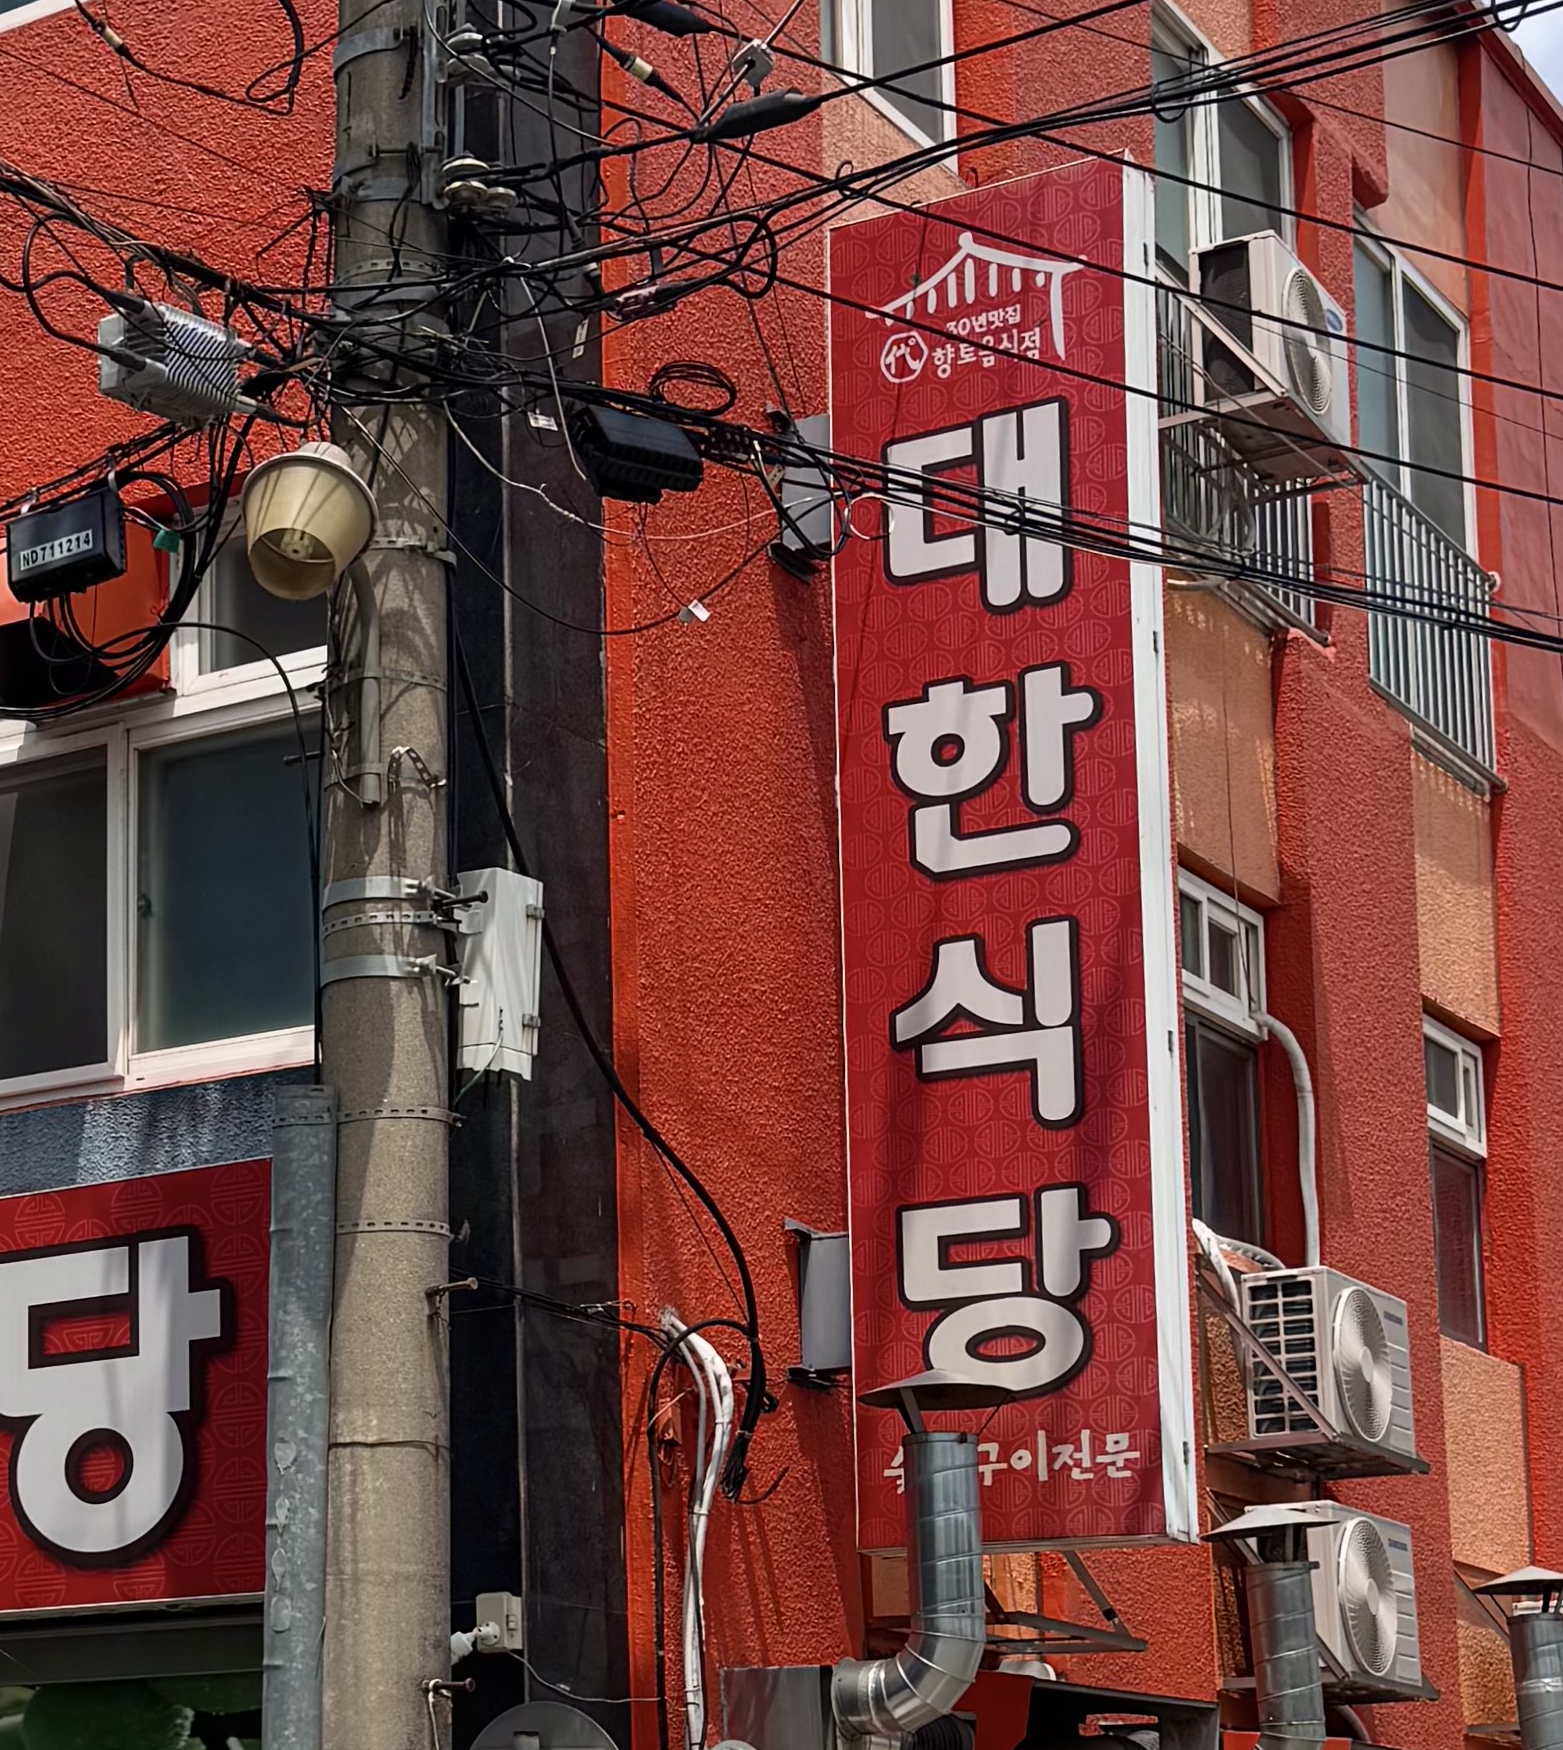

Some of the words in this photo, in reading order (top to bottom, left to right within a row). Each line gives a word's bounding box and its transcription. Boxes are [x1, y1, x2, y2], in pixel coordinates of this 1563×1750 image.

[22, 532, 91, 568] ND711214
[886, 398, 1116, 1393] 대한식당
[883, 1428, 1142, 1497] 구이전문
